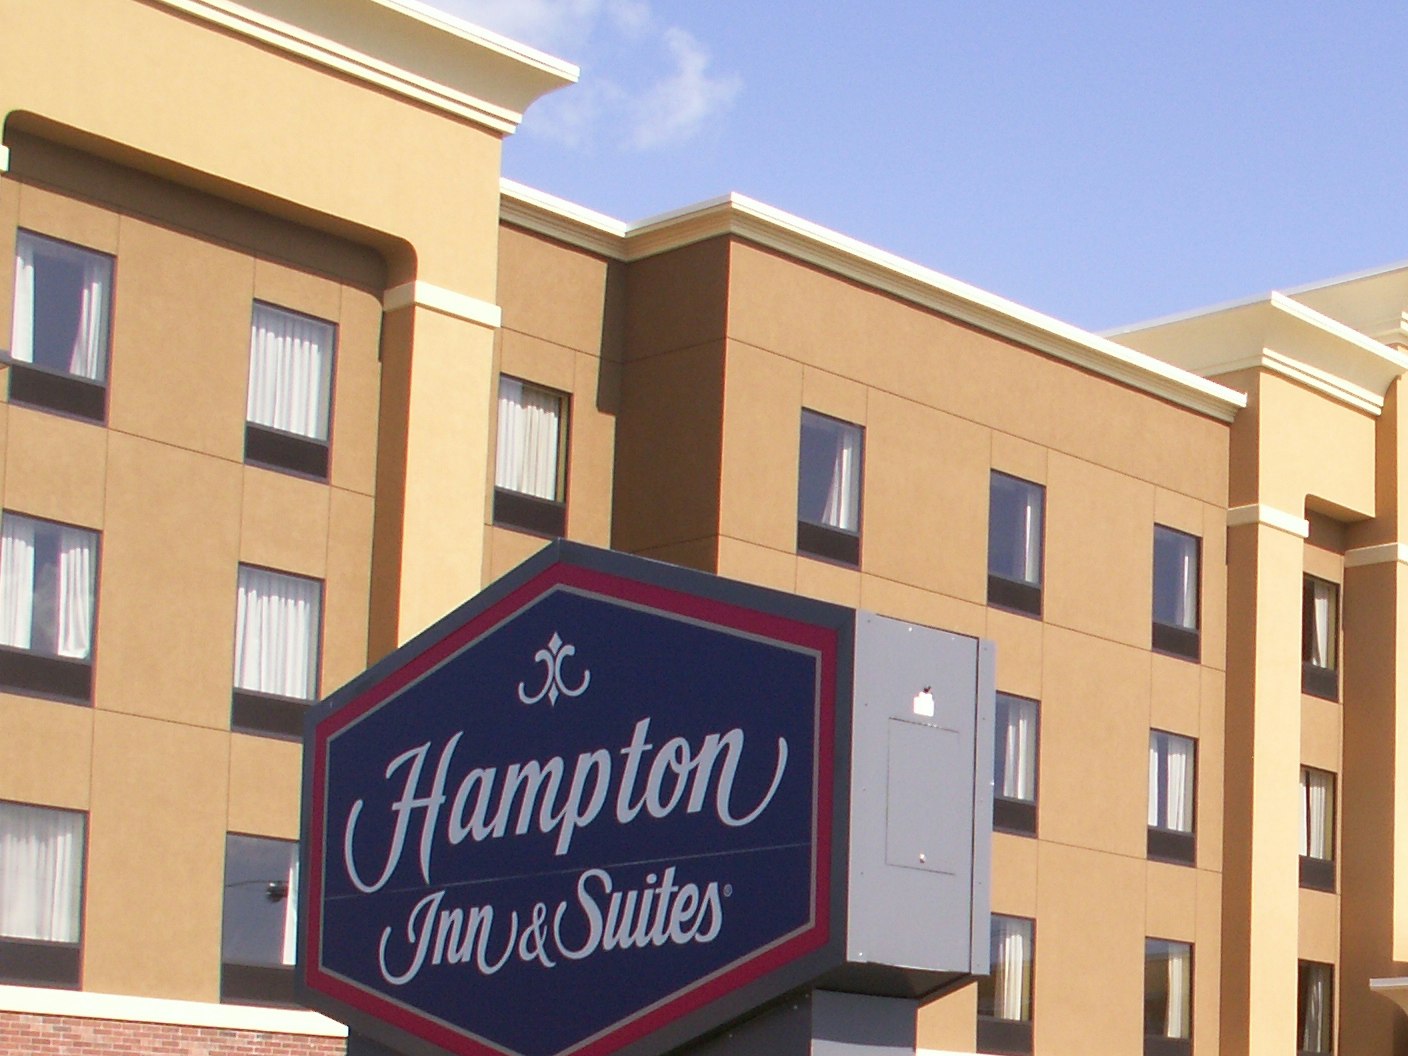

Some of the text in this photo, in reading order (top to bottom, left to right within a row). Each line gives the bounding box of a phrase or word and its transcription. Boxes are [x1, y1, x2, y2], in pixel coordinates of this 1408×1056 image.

[344, 717, 788, 894] Hampton
[379, 891, 518, 985] Inn
[519, 902, 556, 968] &
